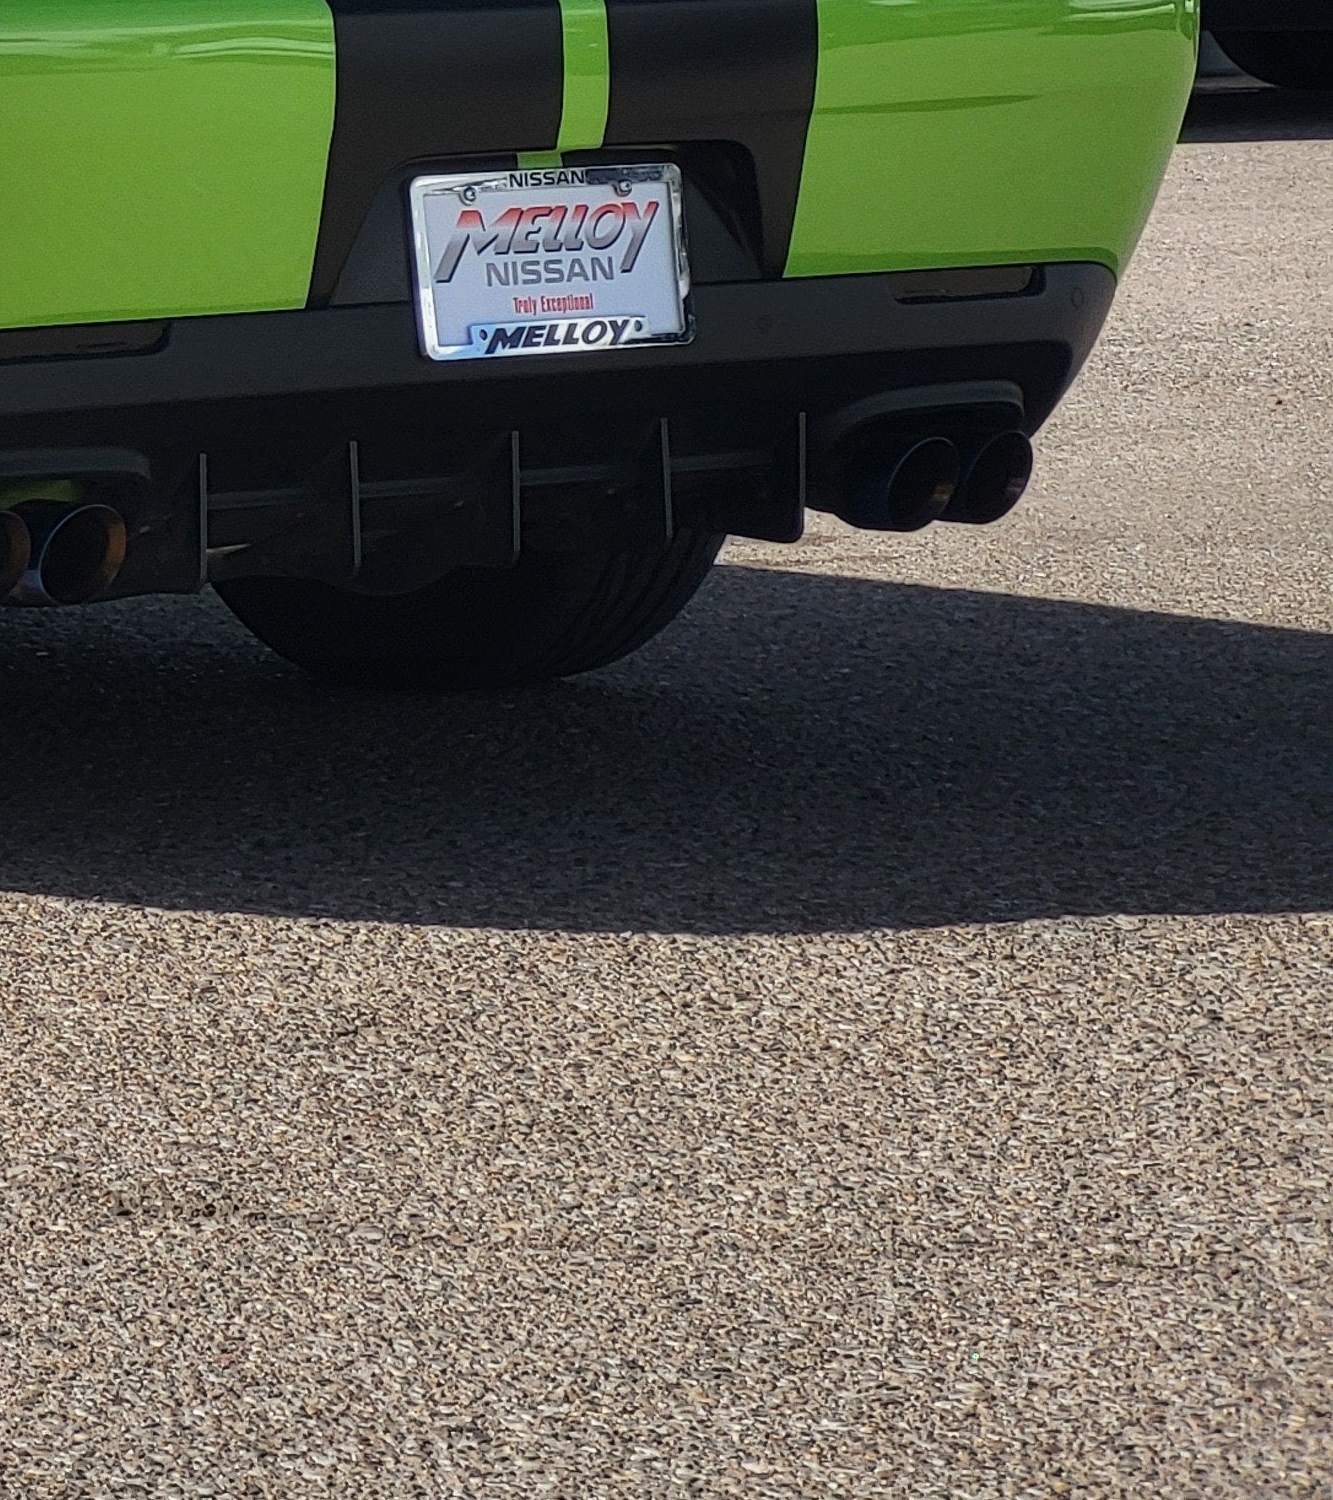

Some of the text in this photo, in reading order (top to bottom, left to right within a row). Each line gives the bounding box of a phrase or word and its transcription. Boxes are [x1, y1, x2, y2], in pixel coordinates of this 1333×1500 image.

[508, 169, 585, 188] NISSAN
[435, 200, 659, 284] MELLOY
[486, 256, 615, 287] NISSAN
[513, 293, 594, 316] Truly Exceptional
[484, 318, 630, 354] MELLOY
